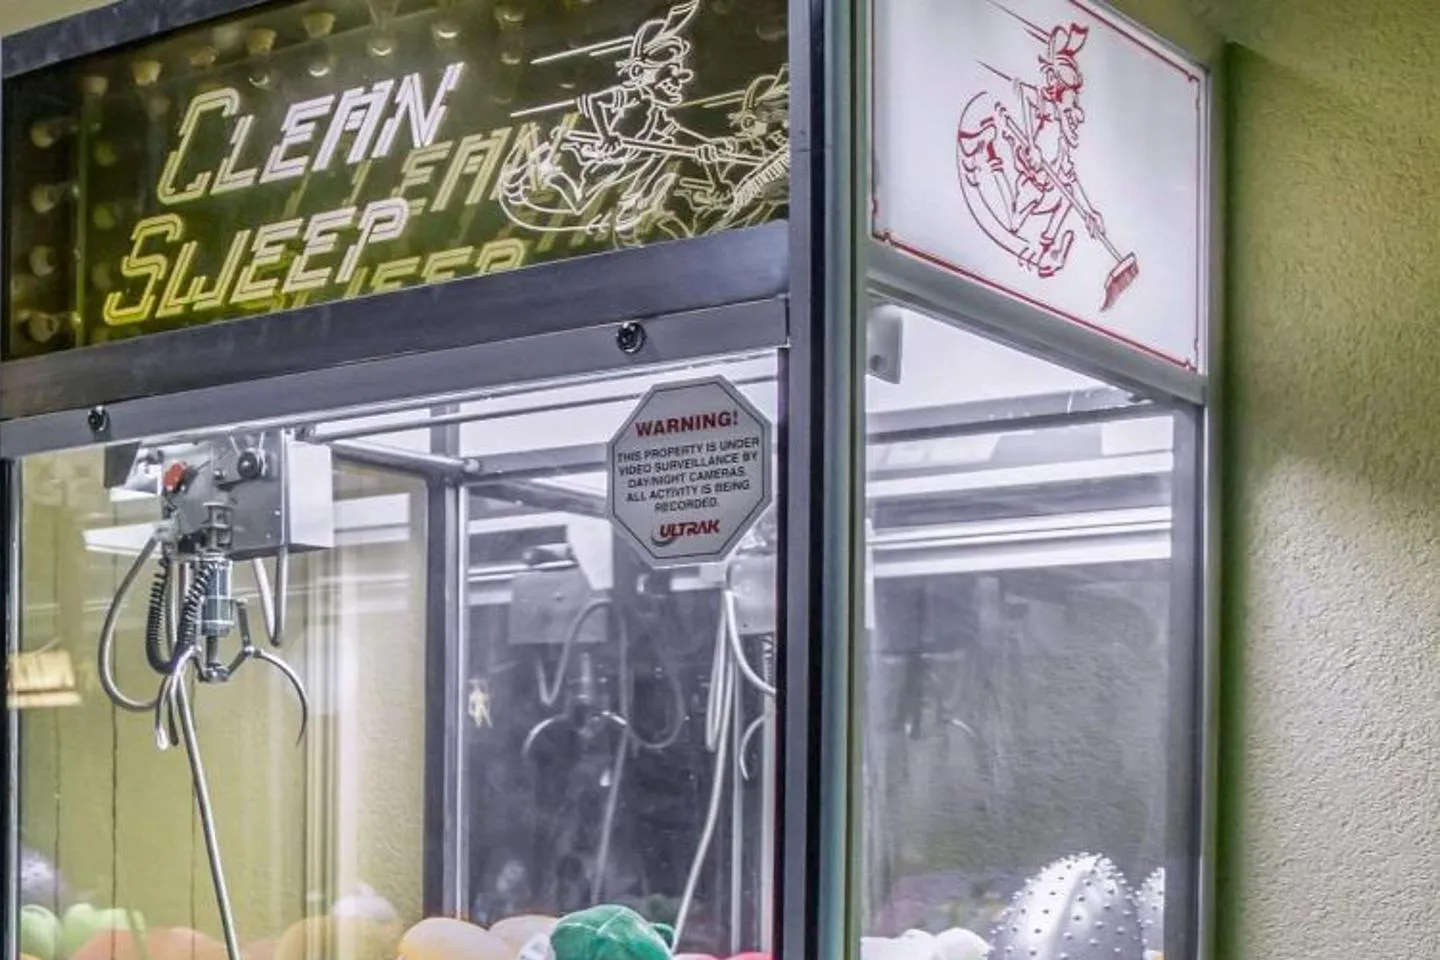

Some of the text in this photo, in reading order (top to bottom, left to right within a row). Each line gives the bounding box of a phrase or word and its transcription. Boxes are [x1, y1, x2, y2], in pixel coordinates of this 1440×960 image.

[157, 61, 466, 205] CLEAN
[103, 198, 409, 327] SWEEP
[635, 410, 739, 437] WARNING!
[618, 436, 760, 463] THIS PROPERTY IS UNDER
[619, 450, 758, 477] VIDEO SURVEILLANCE BY
[626, 479, 750, 502] ALL ACTIVITY IS BEING
[659, 519, 721, 538] ULTRAK
